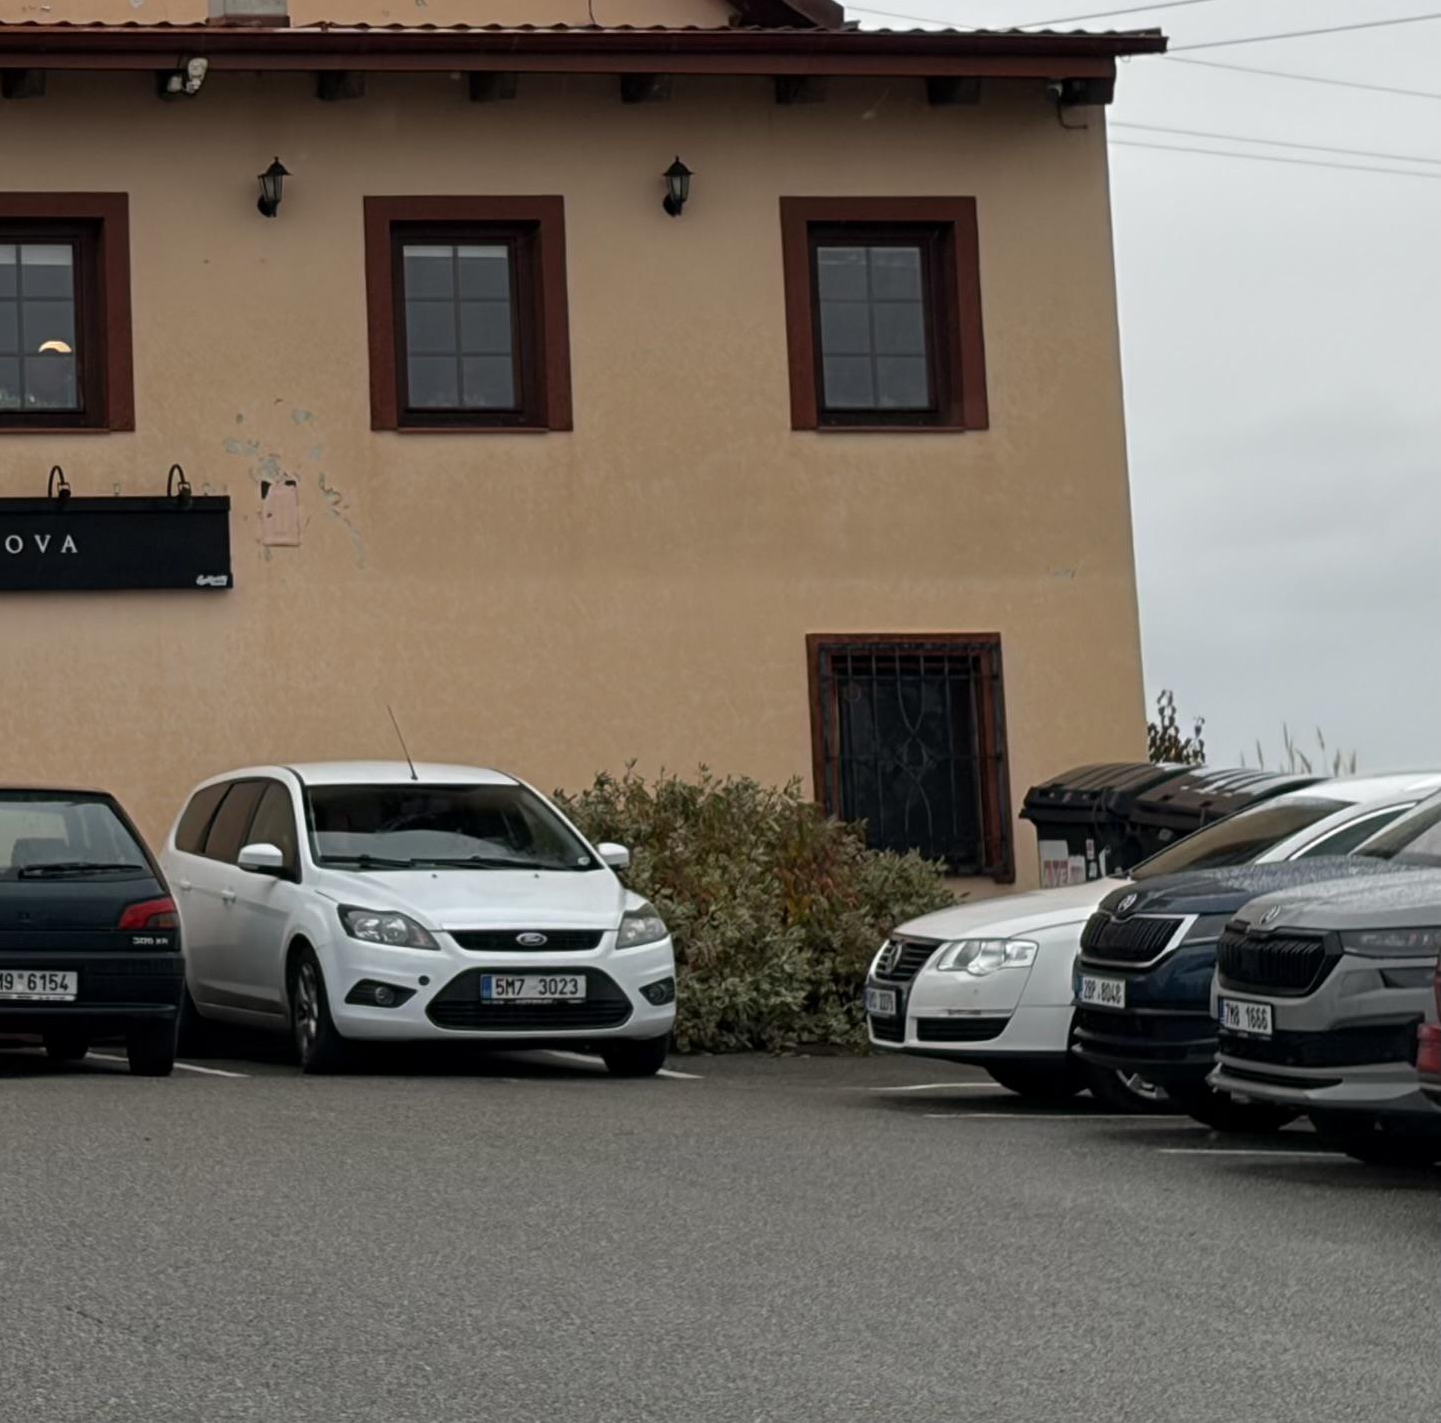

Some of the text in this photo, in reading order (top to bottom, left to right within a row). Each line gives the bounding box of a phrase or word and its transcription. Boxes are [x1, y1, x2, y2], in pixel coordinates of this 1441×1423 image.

[27, 973, 69, 992] 6154
[495, 978, 579, 996] 5M7 3023
